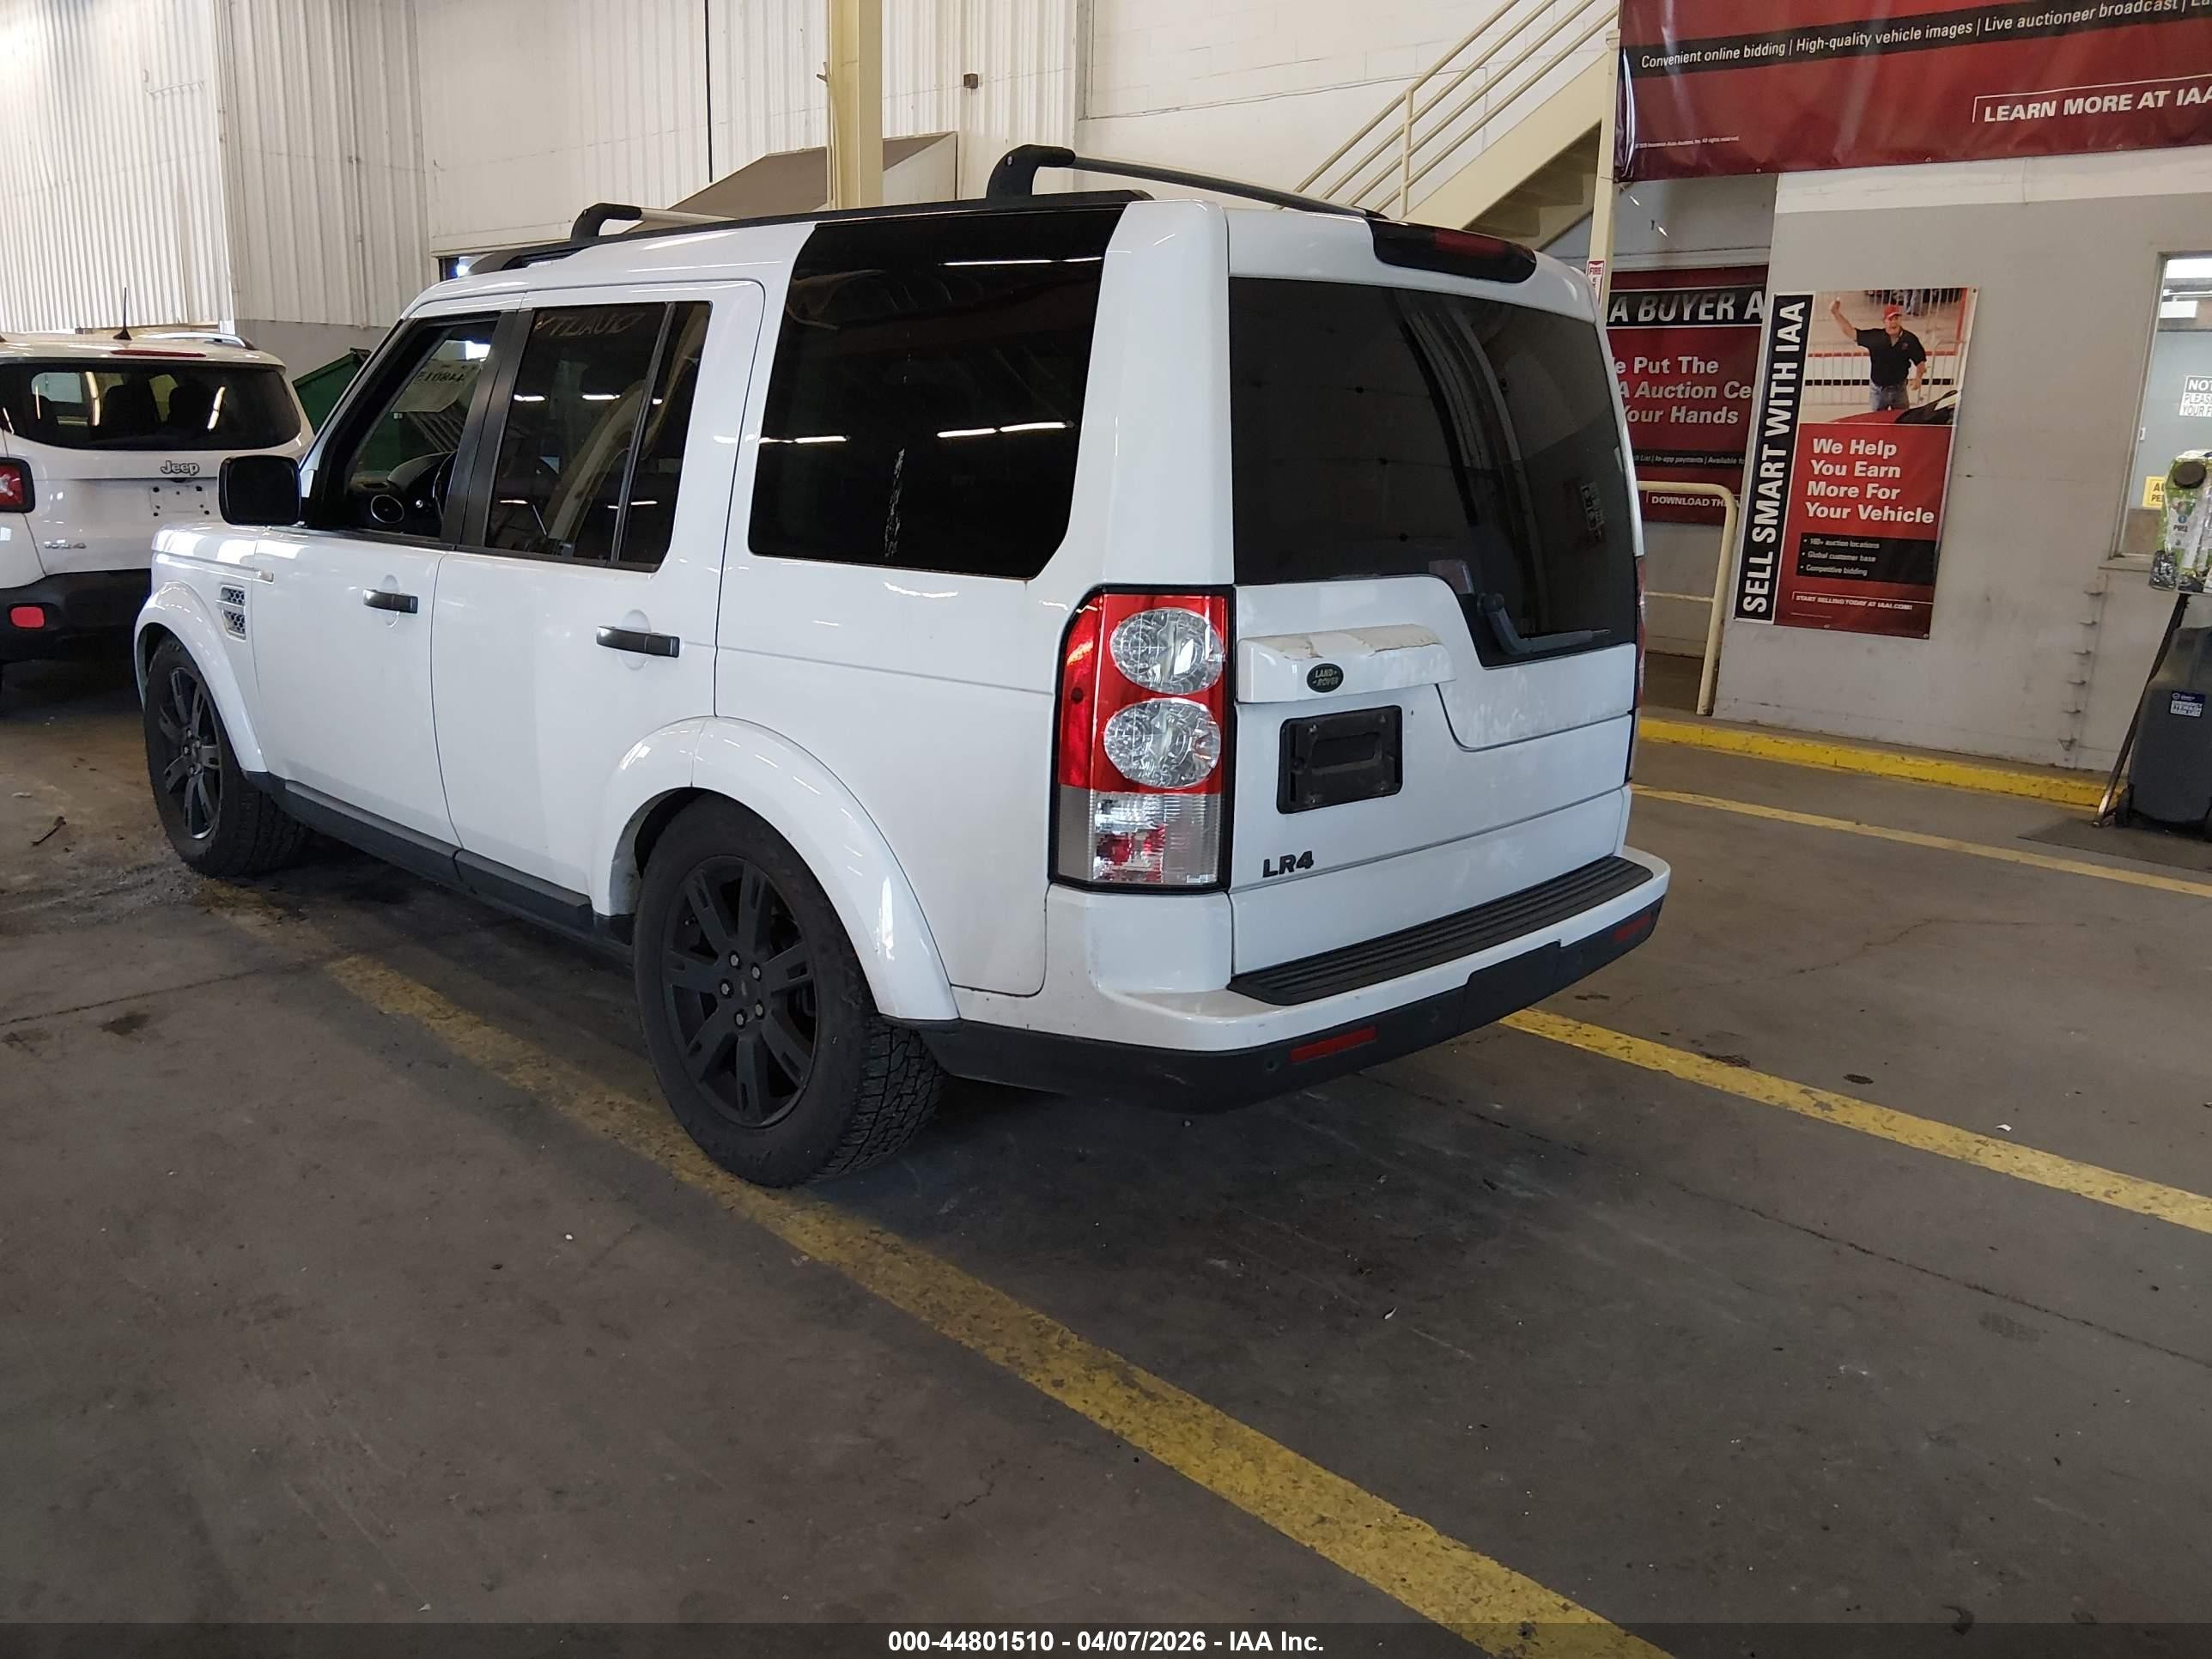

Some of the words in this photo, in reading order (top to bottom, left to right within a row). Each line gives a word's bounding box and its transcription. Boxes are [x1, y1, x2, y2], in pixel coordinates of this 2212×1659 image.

[1641, 51, 1701, 69] Convenient
[1704, 47, 1741, 63] online
[1743, 42, 1786, 58] bidding
[1796, 33, 1871, 54] High-quality
[1875, 27, 1922, 44] vehicle
[1924, 21, 1973, 40] images
[1984, 15, 2012, 32] Live
[2017, 9, 2096, 27] auctioneer
[2099, 0, 2179, 19] broadcast
[1984, 100, 2057, 123] LEARN
[2063, 94, 2133, 115] MORE
[2137, 90, 2171, 108] AT
[1638, 292, 1736, 322] BUYER
[1775, 301, 1806, 352] IAA
[1613, 356, 1626, 374] e
[1633, 356, 1671, 374] Put
[1677, 356, 1719, 374] The
[1633, 380, 1717, 399] Auction
[1764, 362, 1798, 437] WITH
[1669, 405, 1740, 424] Hands
[1813, 438, 1844, 454] We
[1849, 439, 1897, 459] Help
[160, 459, 200, 476] Jeep
[1811, 459, 1847, 476] You
[1854, 460, 1901, 478] Earn
[1751, 444, 1788, 544] SMART
[1807, 480, 1859, 497] More
[1865, 483, 1900, 500] For
[1651, 496, 1711, 507] DOWNLOAD
[1711, 498, 1727, 507] TH
[1805, 501, 1851, 519] Your
[1857, 504, 1935, 523] Vehicle
[1742, 551, 1773, 613] SELL
[1315, 669, 1334, 678] LAND
[1262, 850, 1314, 878] LR4
